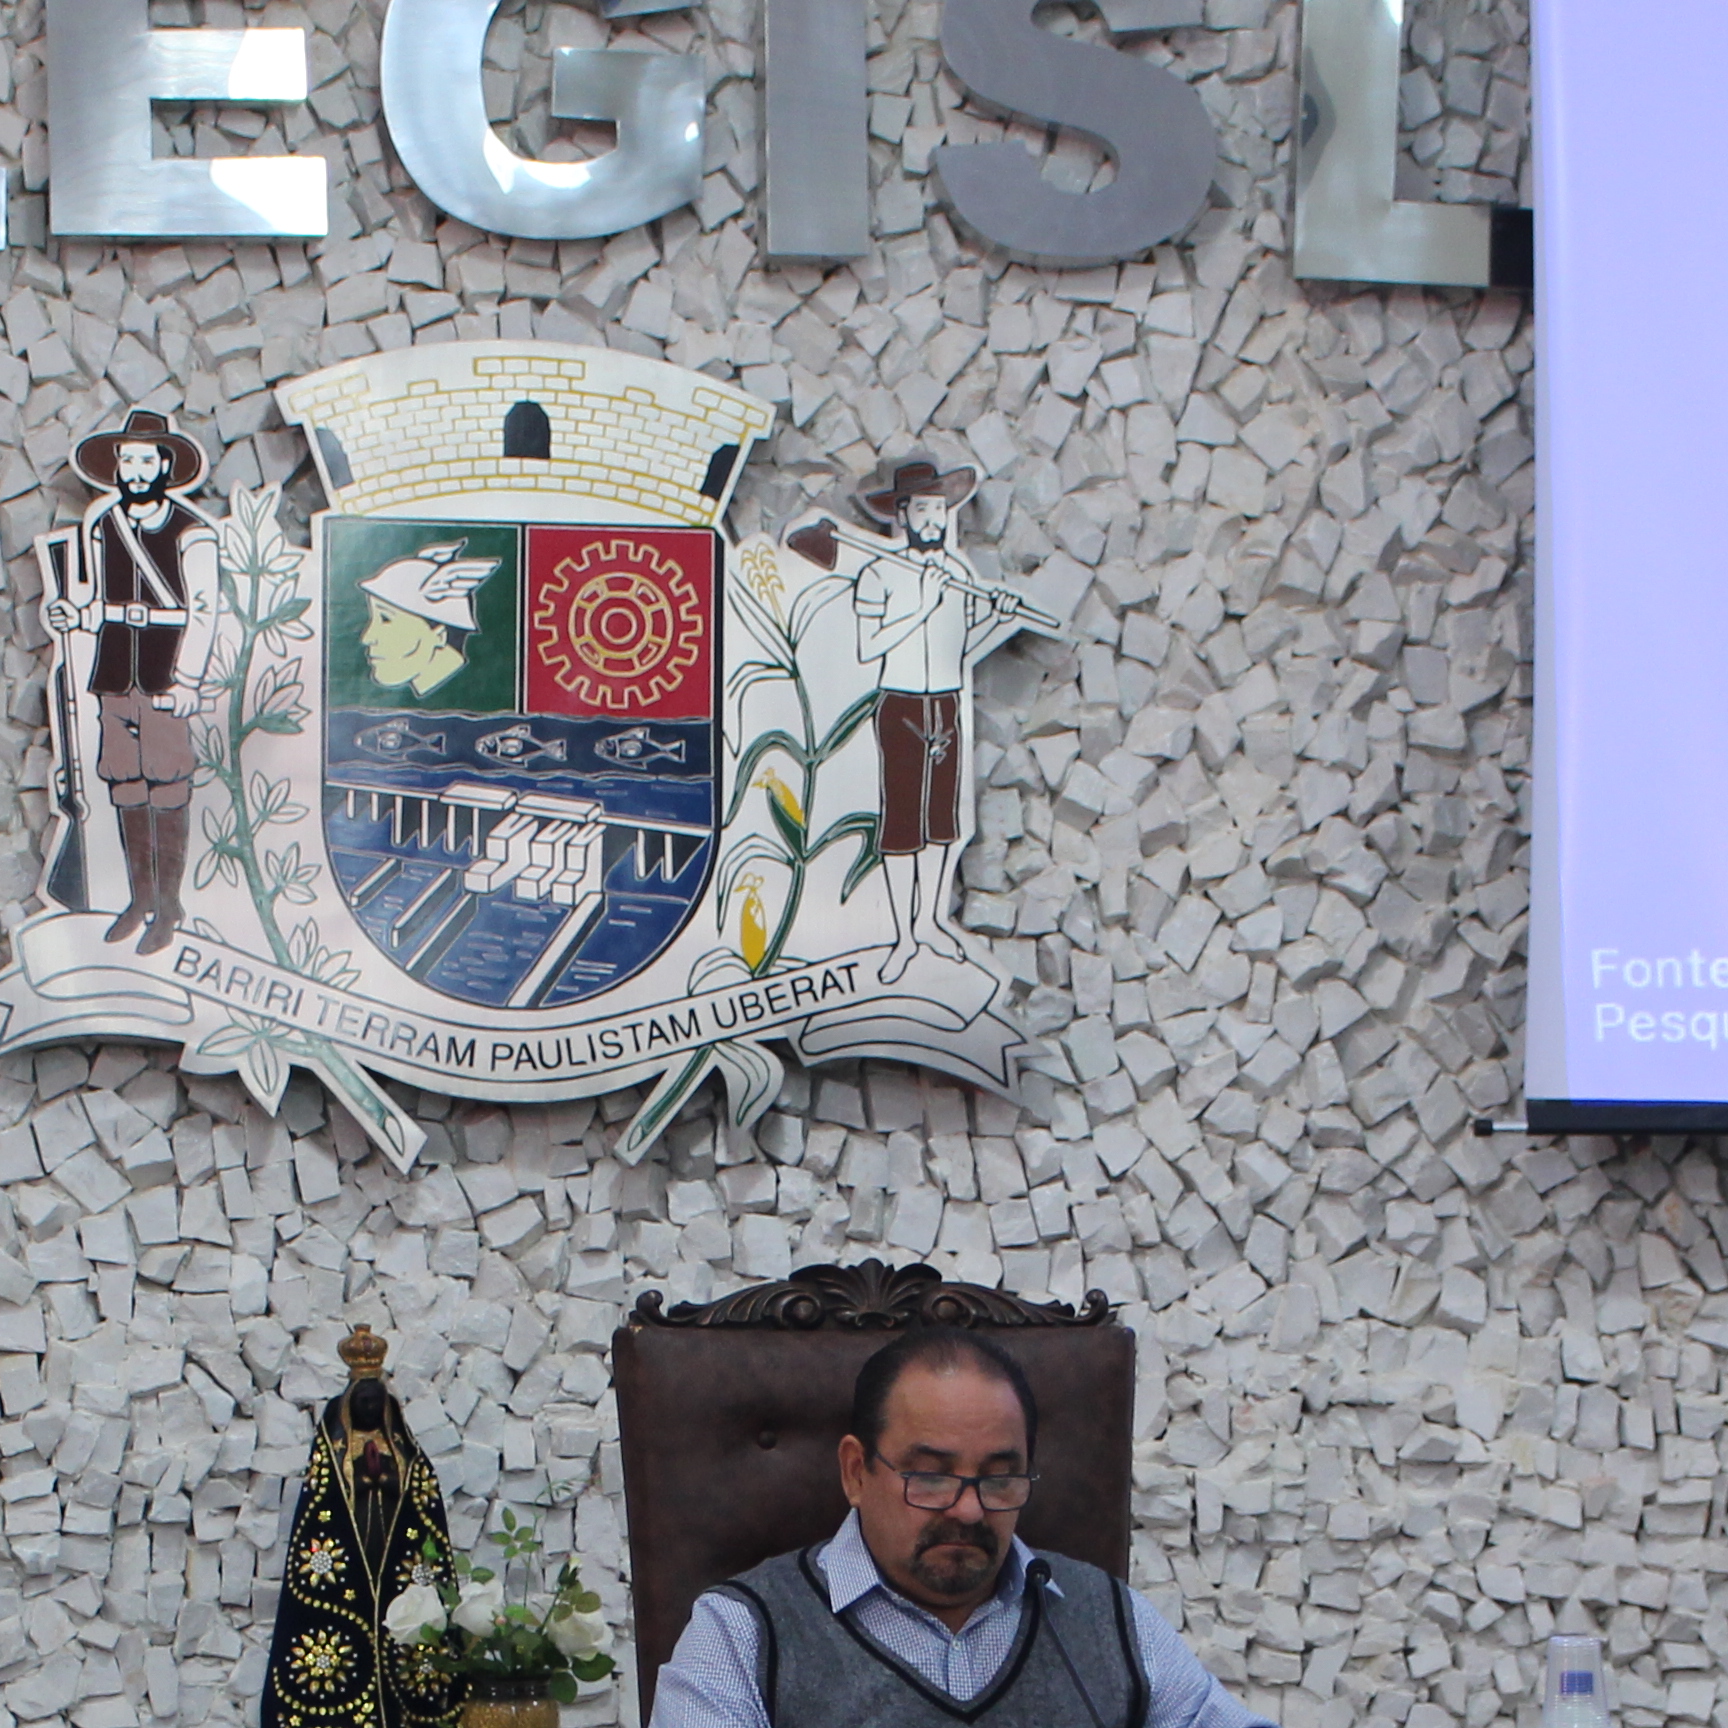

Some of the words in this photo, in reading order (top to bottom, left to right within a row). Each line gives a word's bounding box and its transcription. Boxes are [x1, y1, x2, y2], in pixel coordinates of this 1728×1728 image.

[173, 946, 304, 1017] BARIRI
[316, 994, 475, 1068] TERRAM
[490, 1007, 702, 1072] PAULISTAM
[711, 962, 860, 1030] UBERAT
